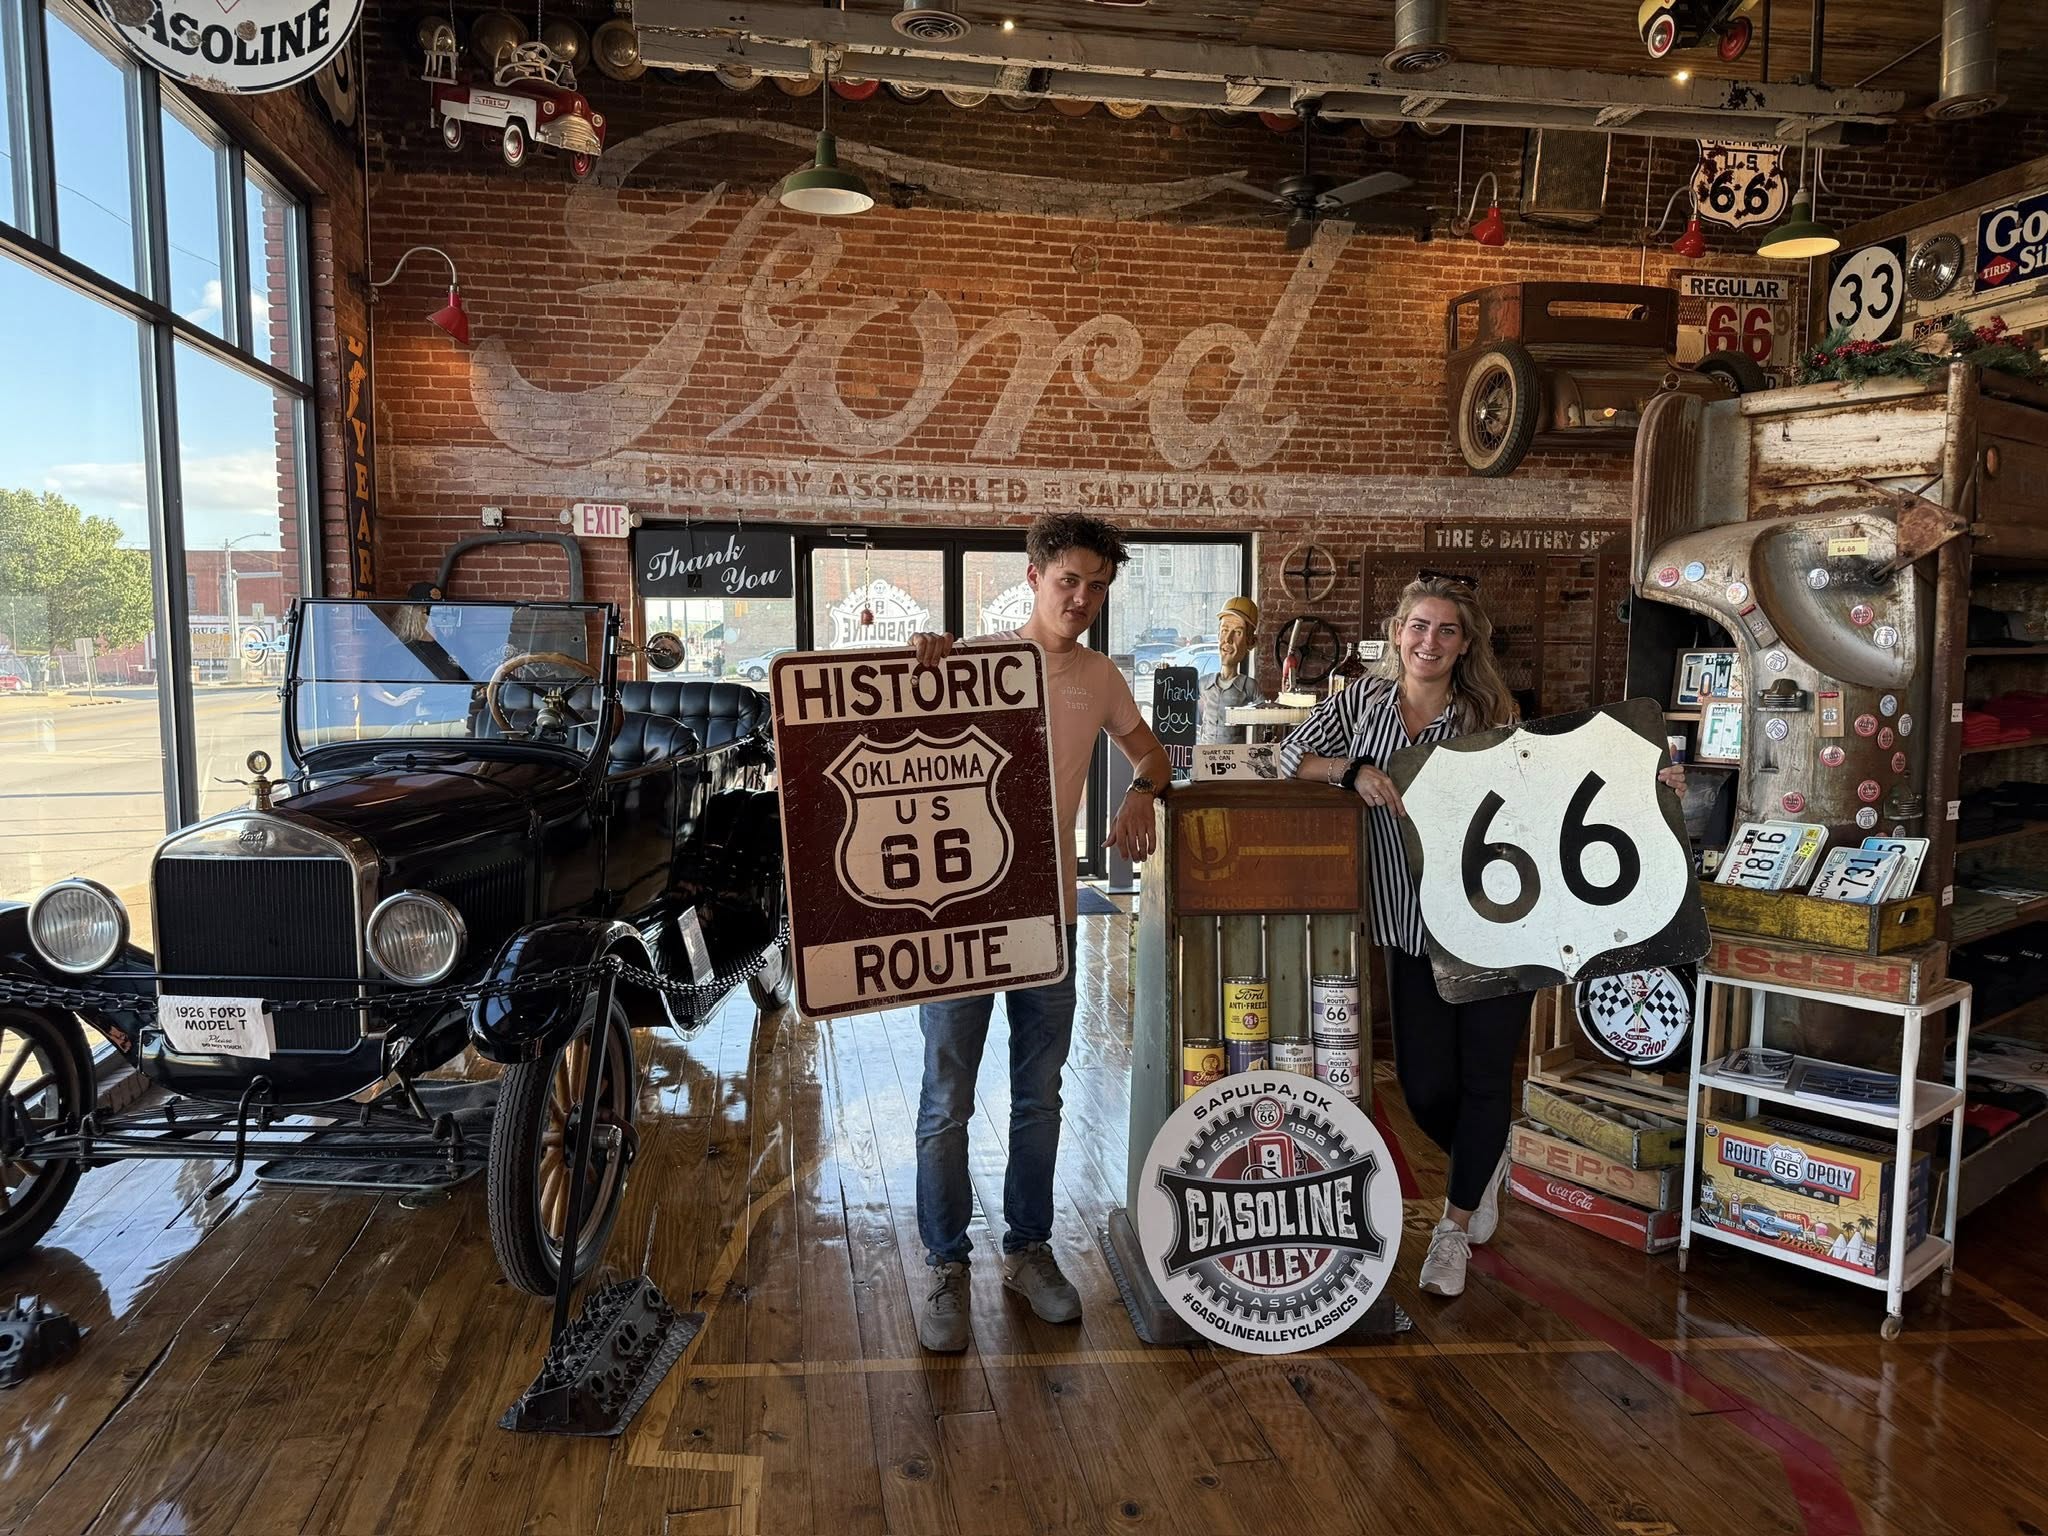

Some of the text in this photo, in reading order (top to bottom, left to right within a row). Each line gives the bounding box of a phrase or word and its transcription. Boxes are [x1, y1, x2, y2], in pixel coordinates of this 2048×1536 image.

[134, 0, 331, 66] ASOLINE
[1709, 169, 1770, 215] 66
[1983, 261, 2012, 279] TIRES
[468, 118, 1355, 470] Ford
[1690, 278, 1779, 298] REGULAR
[1835, 263, 1894, 327] 33
[1707, 305, 1773, 362] 66
[645, 465, 812, 498] PROUDLY
[828, 472, 1029, 503] ASSEMBLED
[583, 505, 623, 535] EXIT
[1435, 529, 1474, 548] TIRE
[1480, 528, 1494, 549] &
[1500, 529, 1575, 550] BATTERY
[646, 534, 746, 582] Thank
[720, 565, 783, 594] You
[794, 655, 1026, 721] HISTORIC
[1156, 676, 1199, 702] Thank
[1156, 704, 1193, 734] You
[852, 752, 985, 789] OKLAHOMA
[881, 827, 972, 891] 66
[1461, 769, 1641, 924] 66
[853, 925, 1012, 996] ROUTE
[1717, 944, 1901, 993] PEPSI
[1234, 988, 1265, 1000] Ford
[175, 1006, 246, 1019] 1926 FORD
[185, 1019, 248, 1031] MODEL T
[1326, 1006, 1347, 1021] 66
[1606, 1031, 1638, 1052] SPEED
[1638, 1040, 1668, 1056] SHOP
[1329, 1069, 1350, 1083] 66
[1193, 1082, 1333, 1120] SAPULPA, OK
[1259, 1111, 1275, 1123] 66
[1210, 1122, 1327, 1152] EST. 1996
[1725, 1140, 1853, 1189] ROUTE OPOLY
[1773, 1160, 1799, 1178] 66
[1780, 1151, 1793, 1161] US
[1184, 1175, 1359, 1253] GASOLINE
[1783, 1212, 1801, 1221] HERE
[1231, 1248, 1320, 1285] ALLEY
[1218, 1273, 1336, 1308] CLASSICS
[1181, 1291, 1359, 1343] #GASOLINEALLEYCLASSICS
